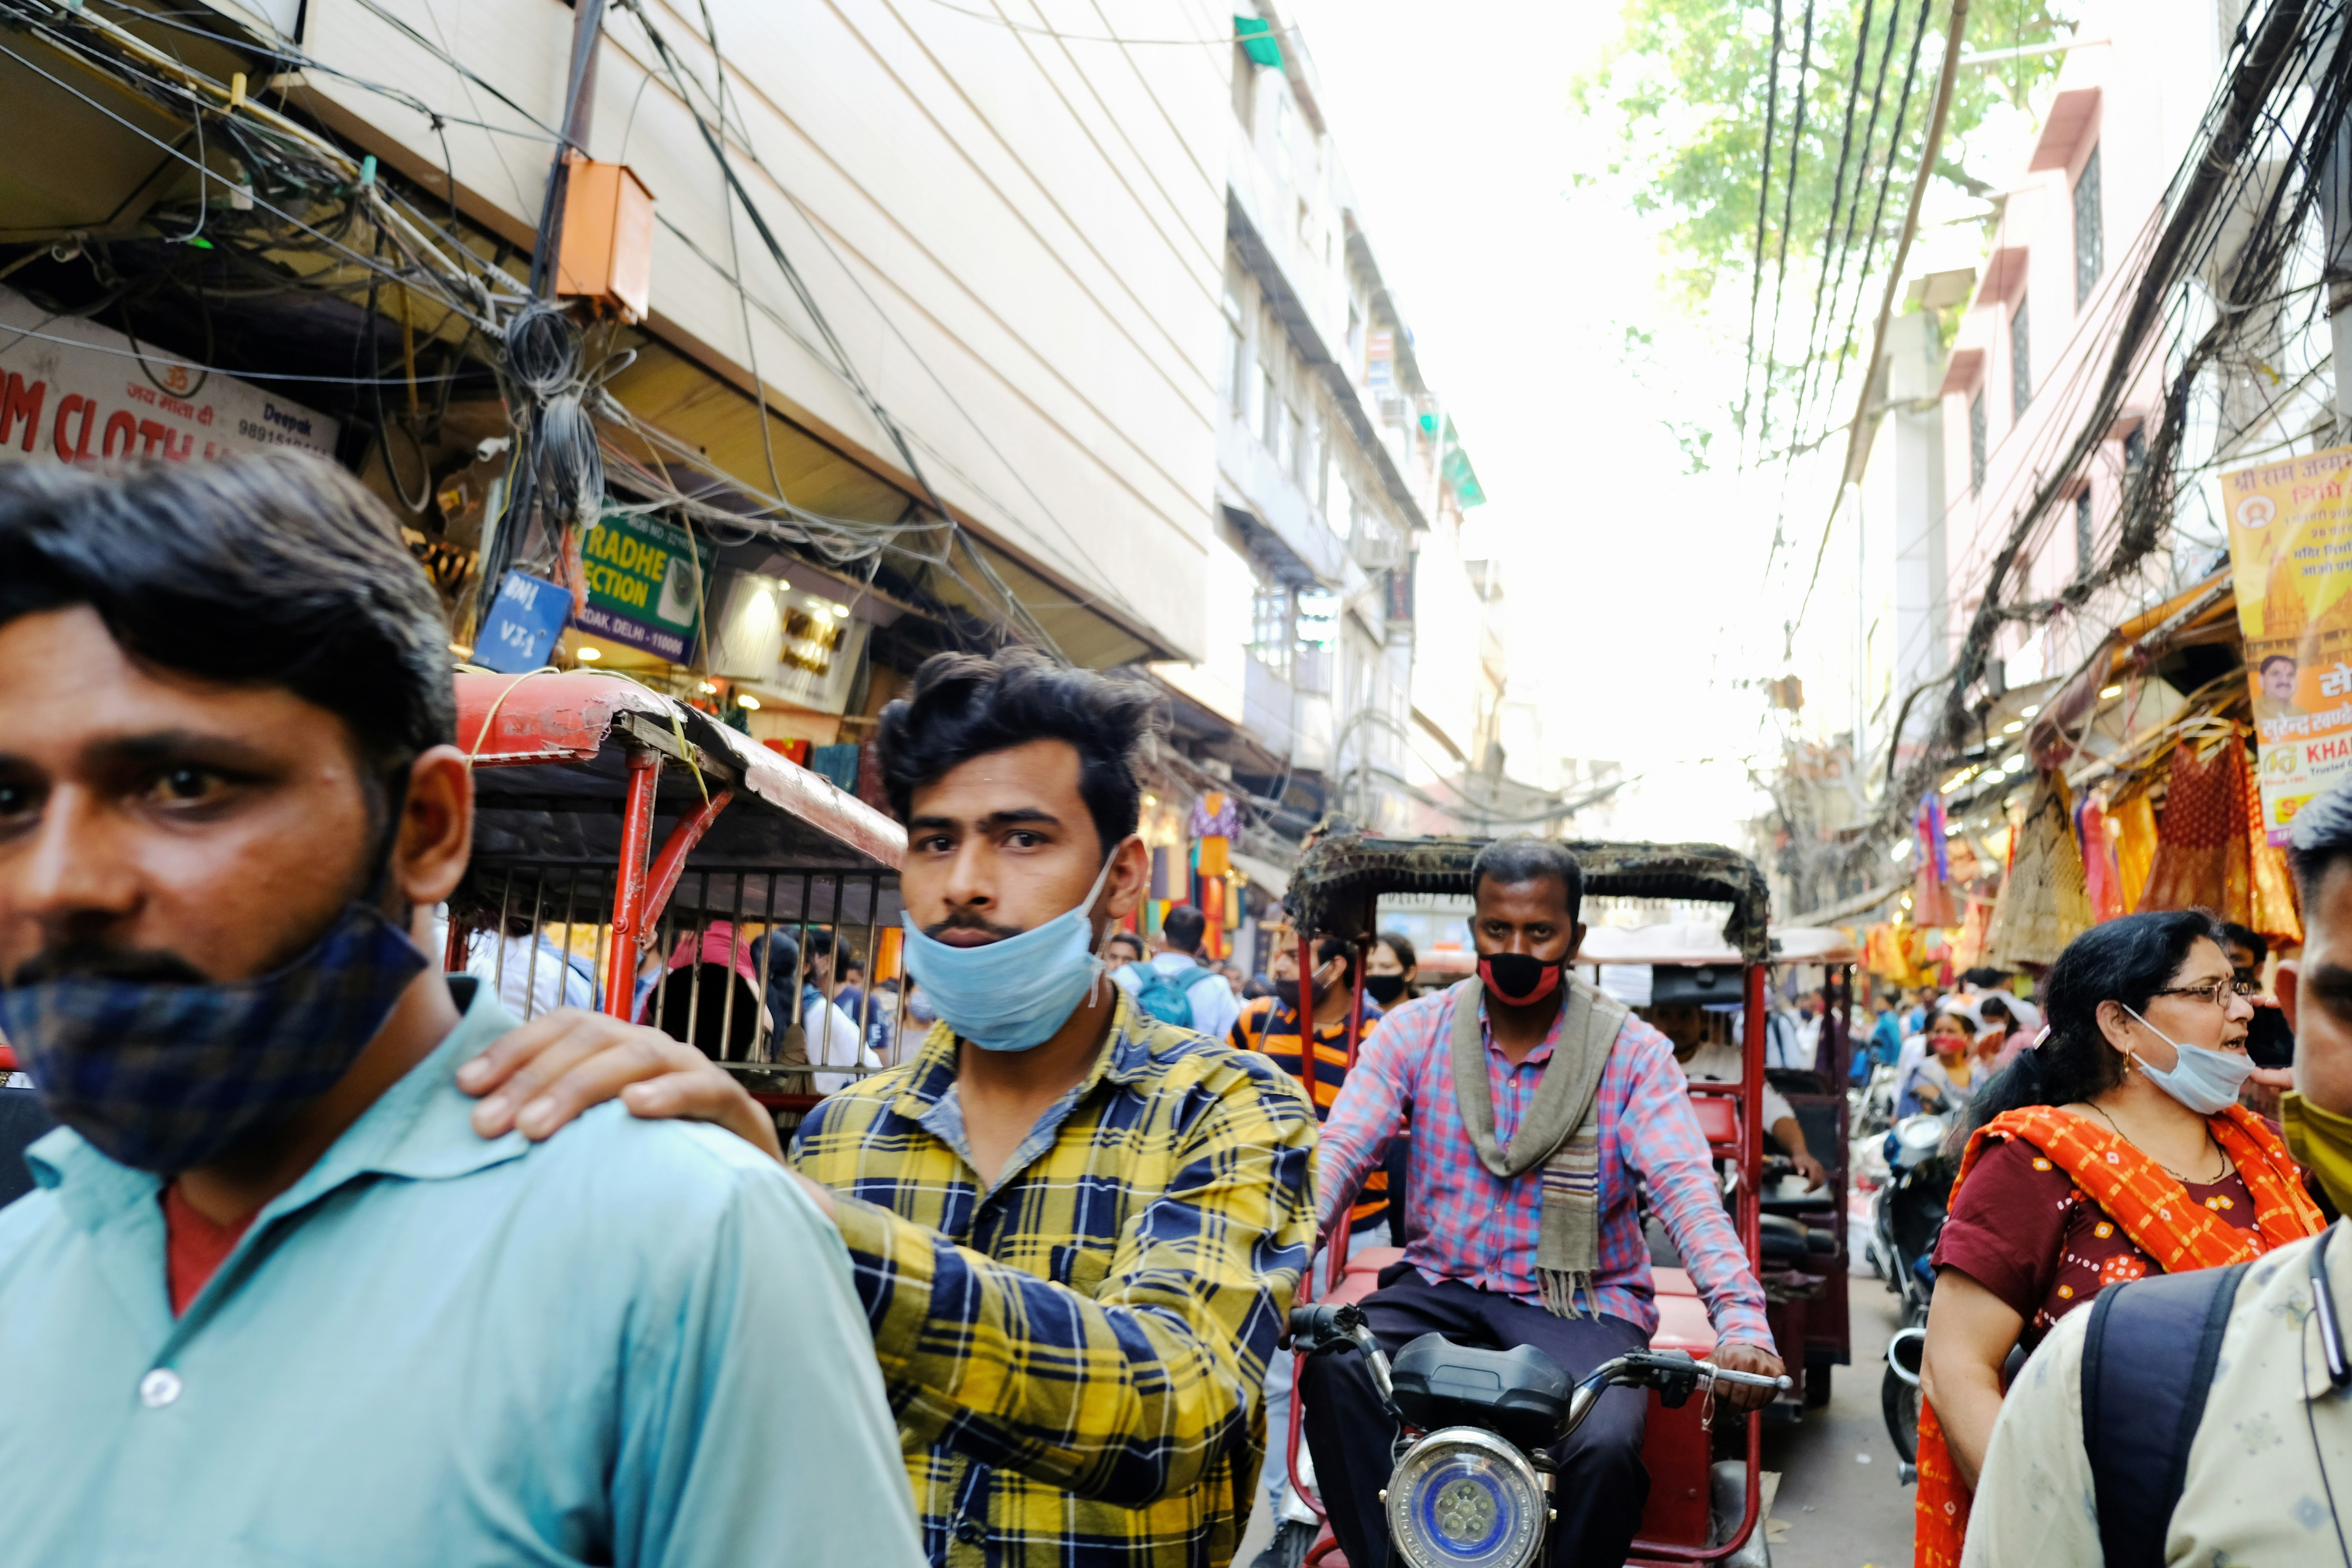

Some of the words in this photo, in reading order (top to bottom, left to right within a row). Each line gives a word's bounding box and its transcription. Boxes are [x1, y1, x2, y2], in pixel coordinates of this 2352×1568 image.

[0, 366, 46, 452] M
[54, 393, 194, 466] CLOTH
[264, 403, 311, 436] Deepak
[586, 523, 667, 582] RADHE
[583, 560, 649, 608] ECTION
[612, 617, 645, 641] DELHI
[2310, 761, 2345, 776] Trusted
